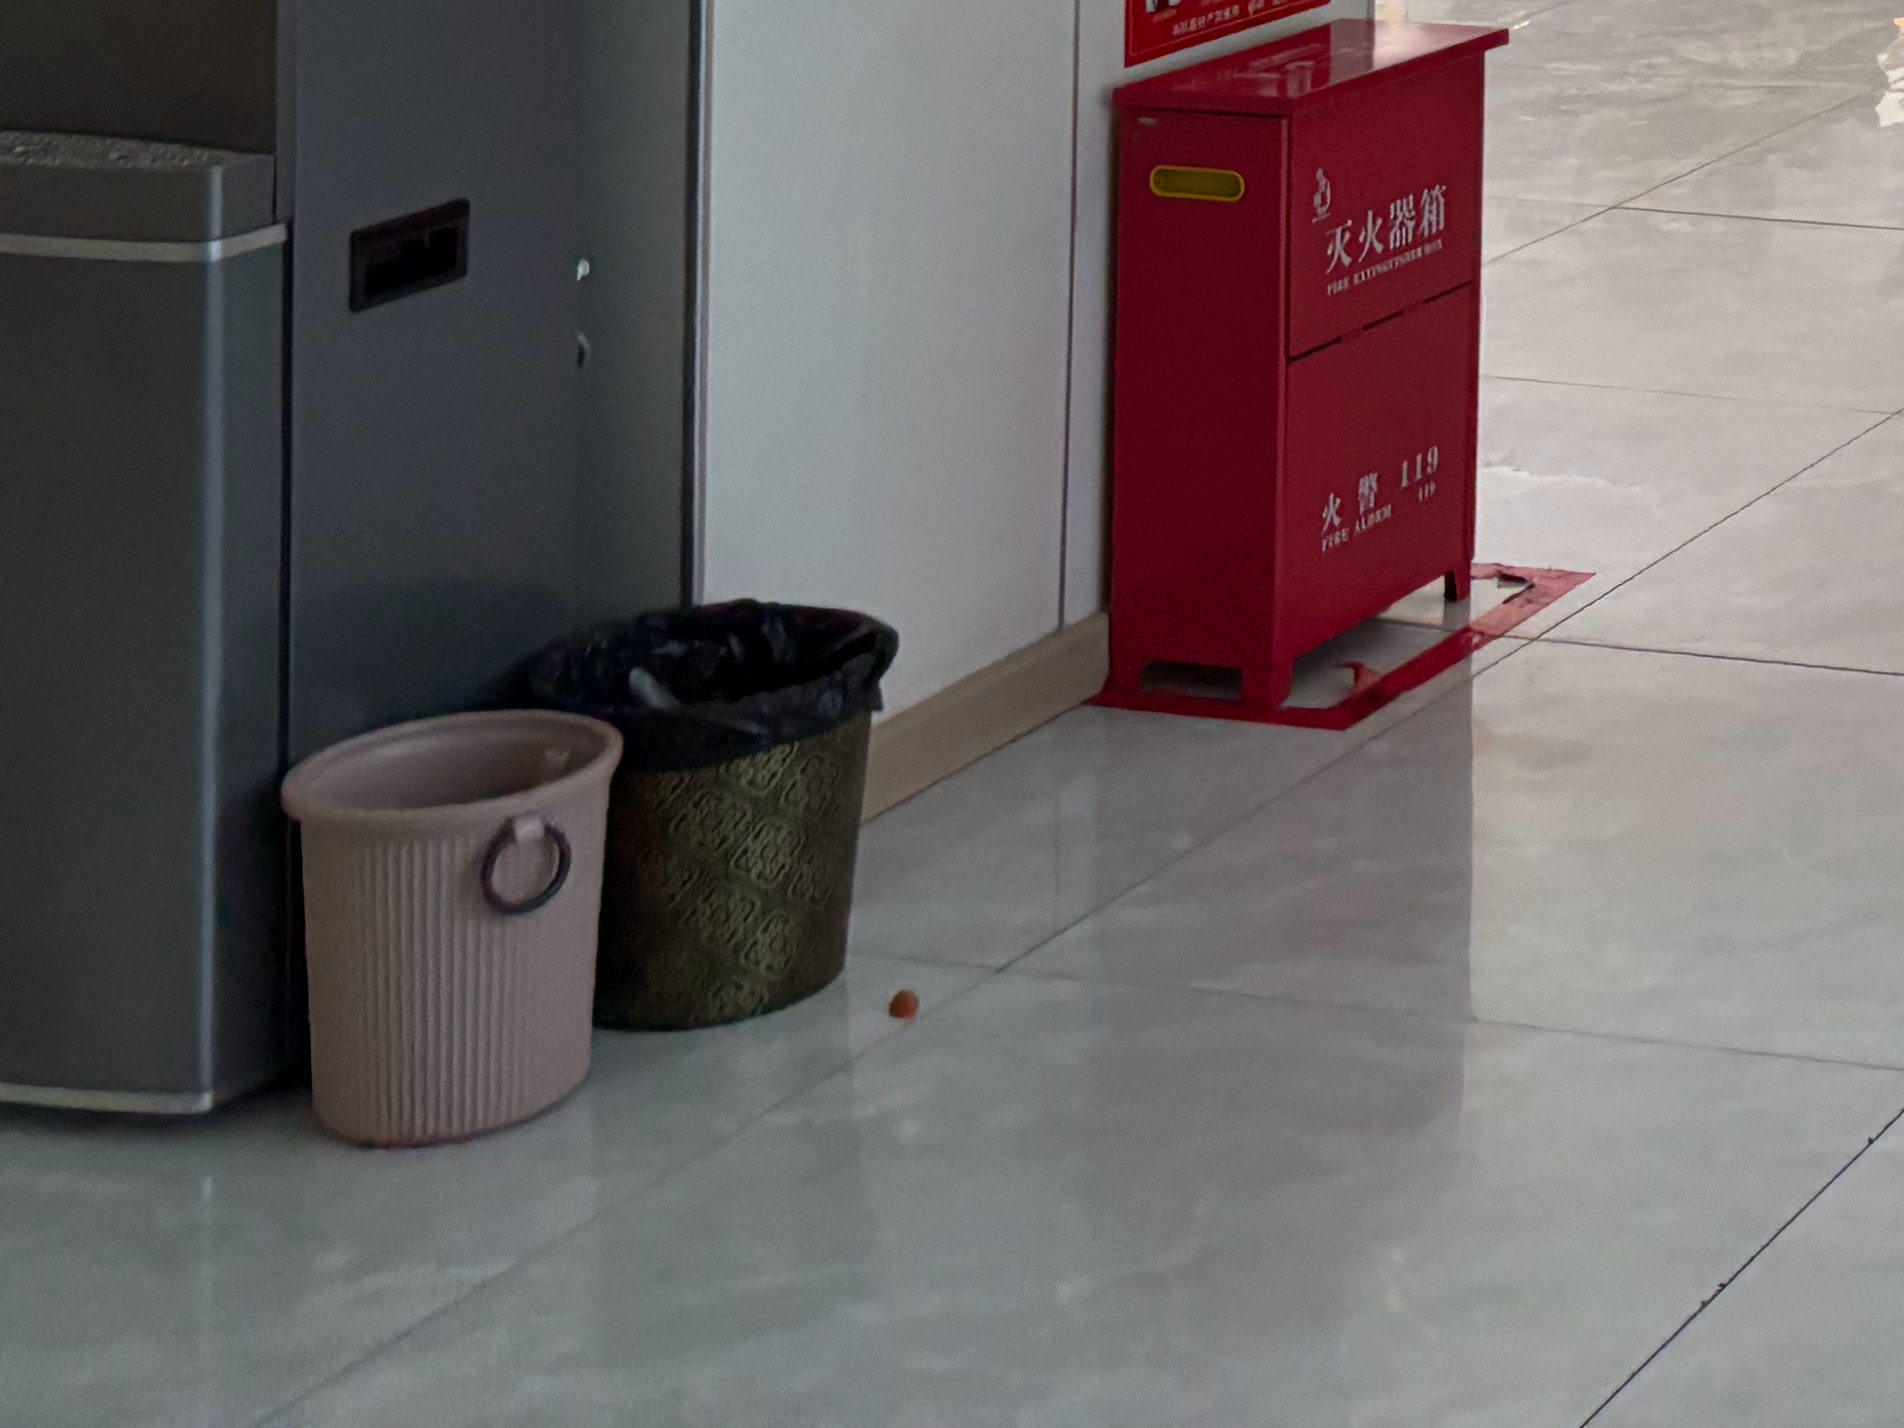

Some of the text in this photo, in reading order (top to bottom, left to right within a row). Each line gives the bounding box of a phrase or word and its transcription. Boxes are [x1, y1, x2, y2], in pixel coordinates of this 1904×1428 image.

[1325, 183, 1447, 275] 灭火器箱
[1321, 445, 1439, 535] 火警 119
